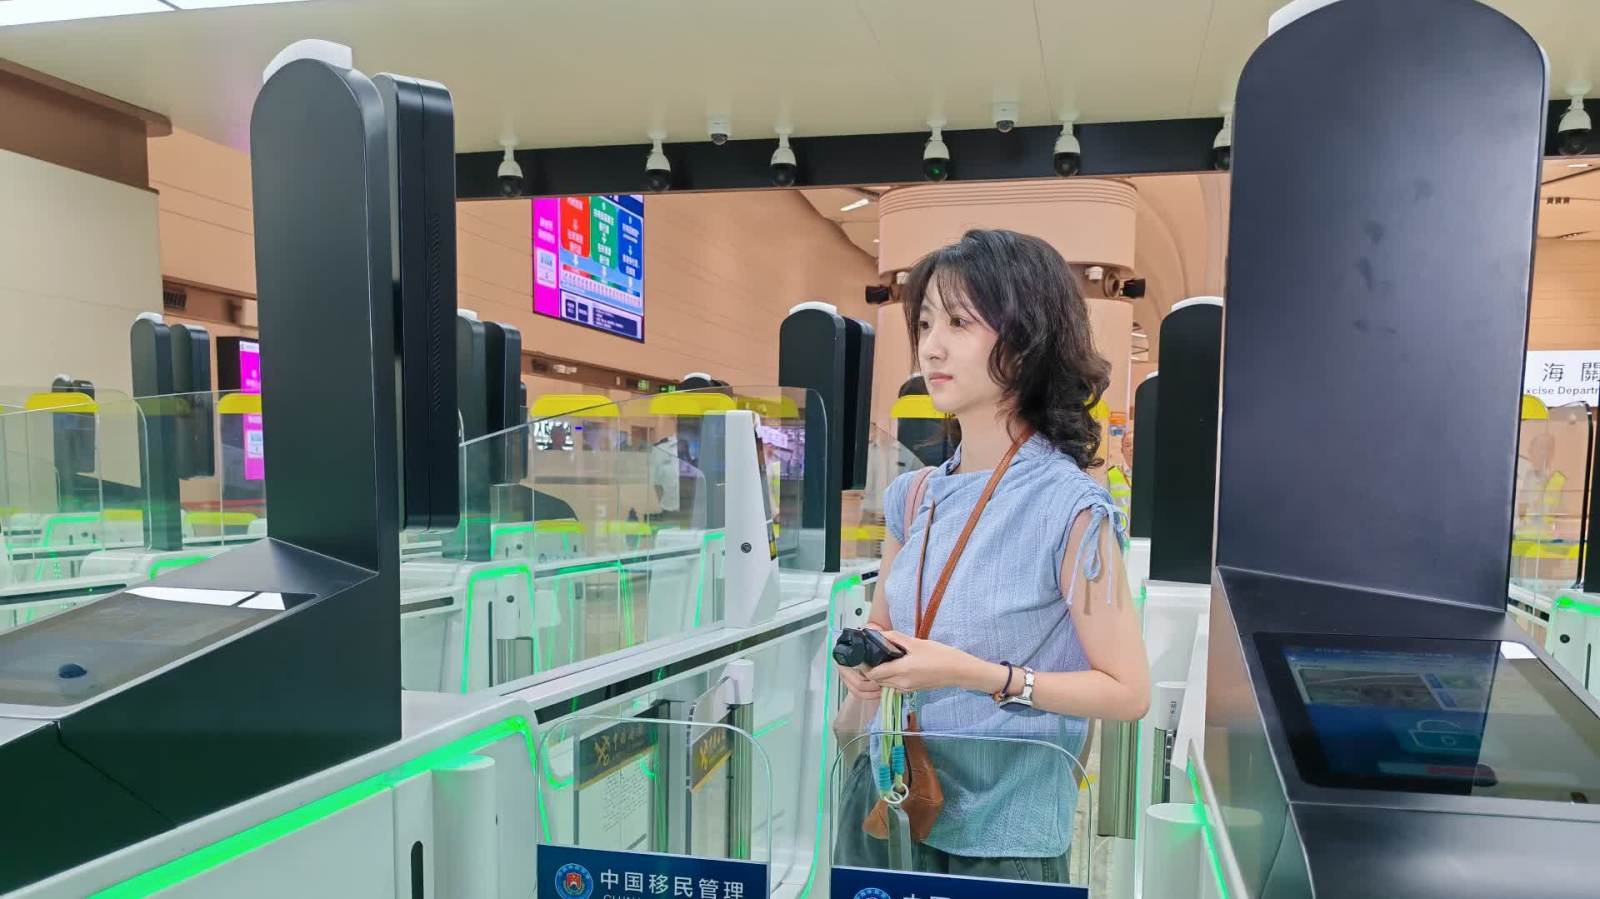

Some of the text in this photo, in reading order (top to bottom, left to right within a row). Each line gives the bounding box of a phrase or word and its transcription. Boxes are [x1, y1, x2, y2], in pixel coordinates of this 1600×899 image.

[1542, 362, 1600, 382] 海關
[1526, 386, 1554, 394] xcise
[600, 869, 744, 899] 中国移民管理
